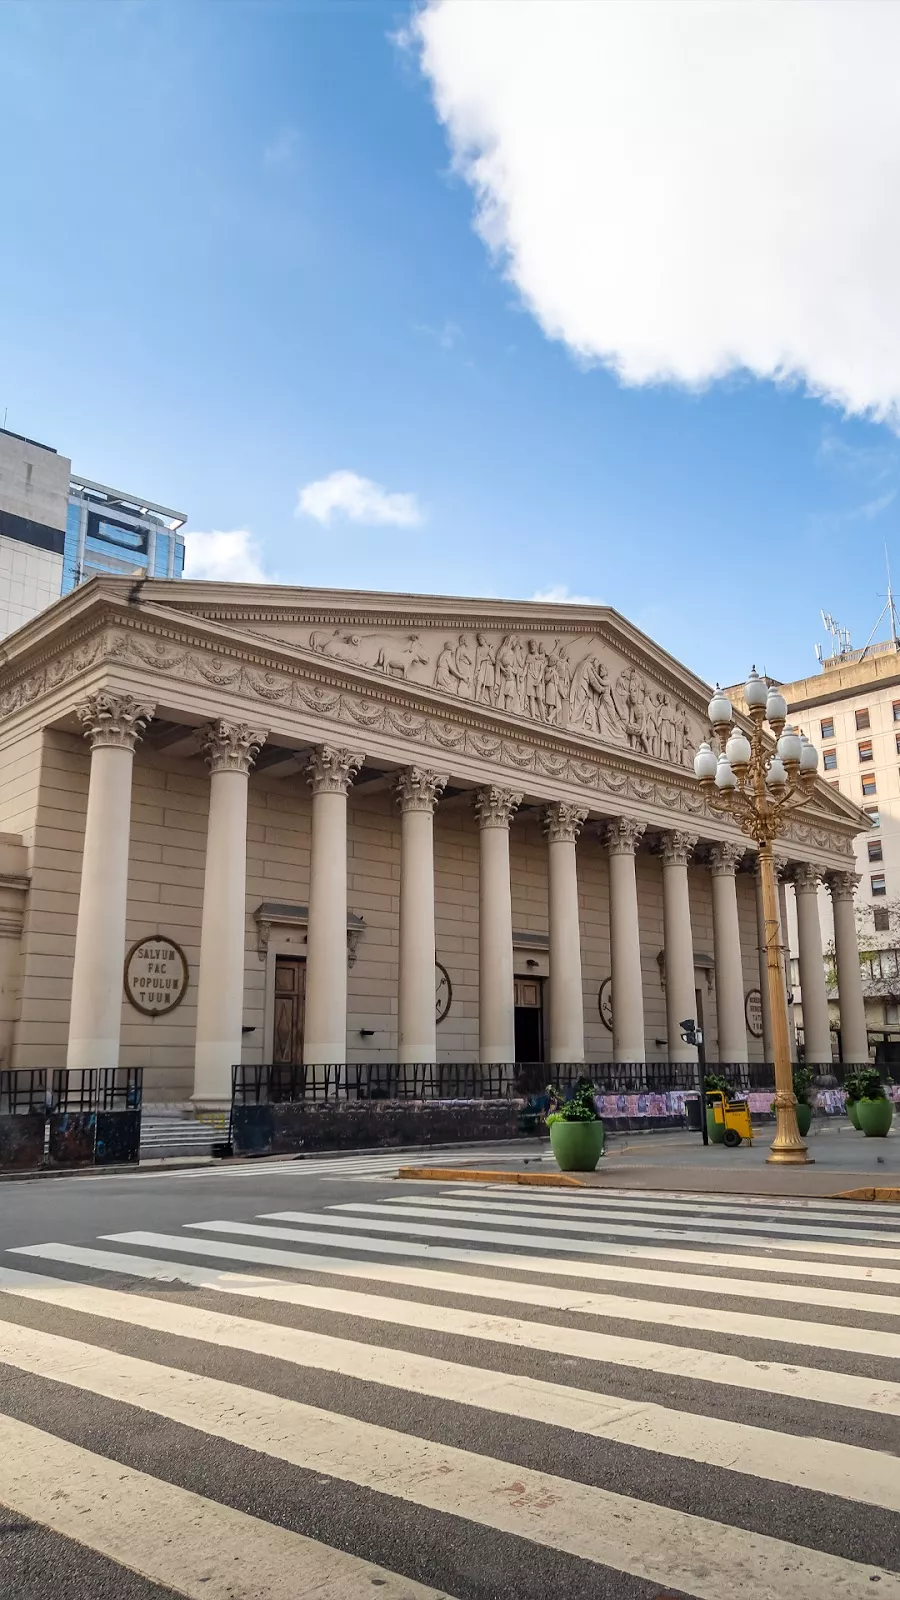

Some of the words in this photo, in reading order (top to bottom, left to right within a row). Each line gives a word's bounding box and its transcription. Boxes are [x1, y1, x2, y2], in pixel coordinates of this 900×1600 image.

[138, 949, 175, 960] SALVUM
[148, 963, 167, 974] FAC
[133, 977, 179, 989] POPULUM
[139, 992, 171, 1003] TUUM
